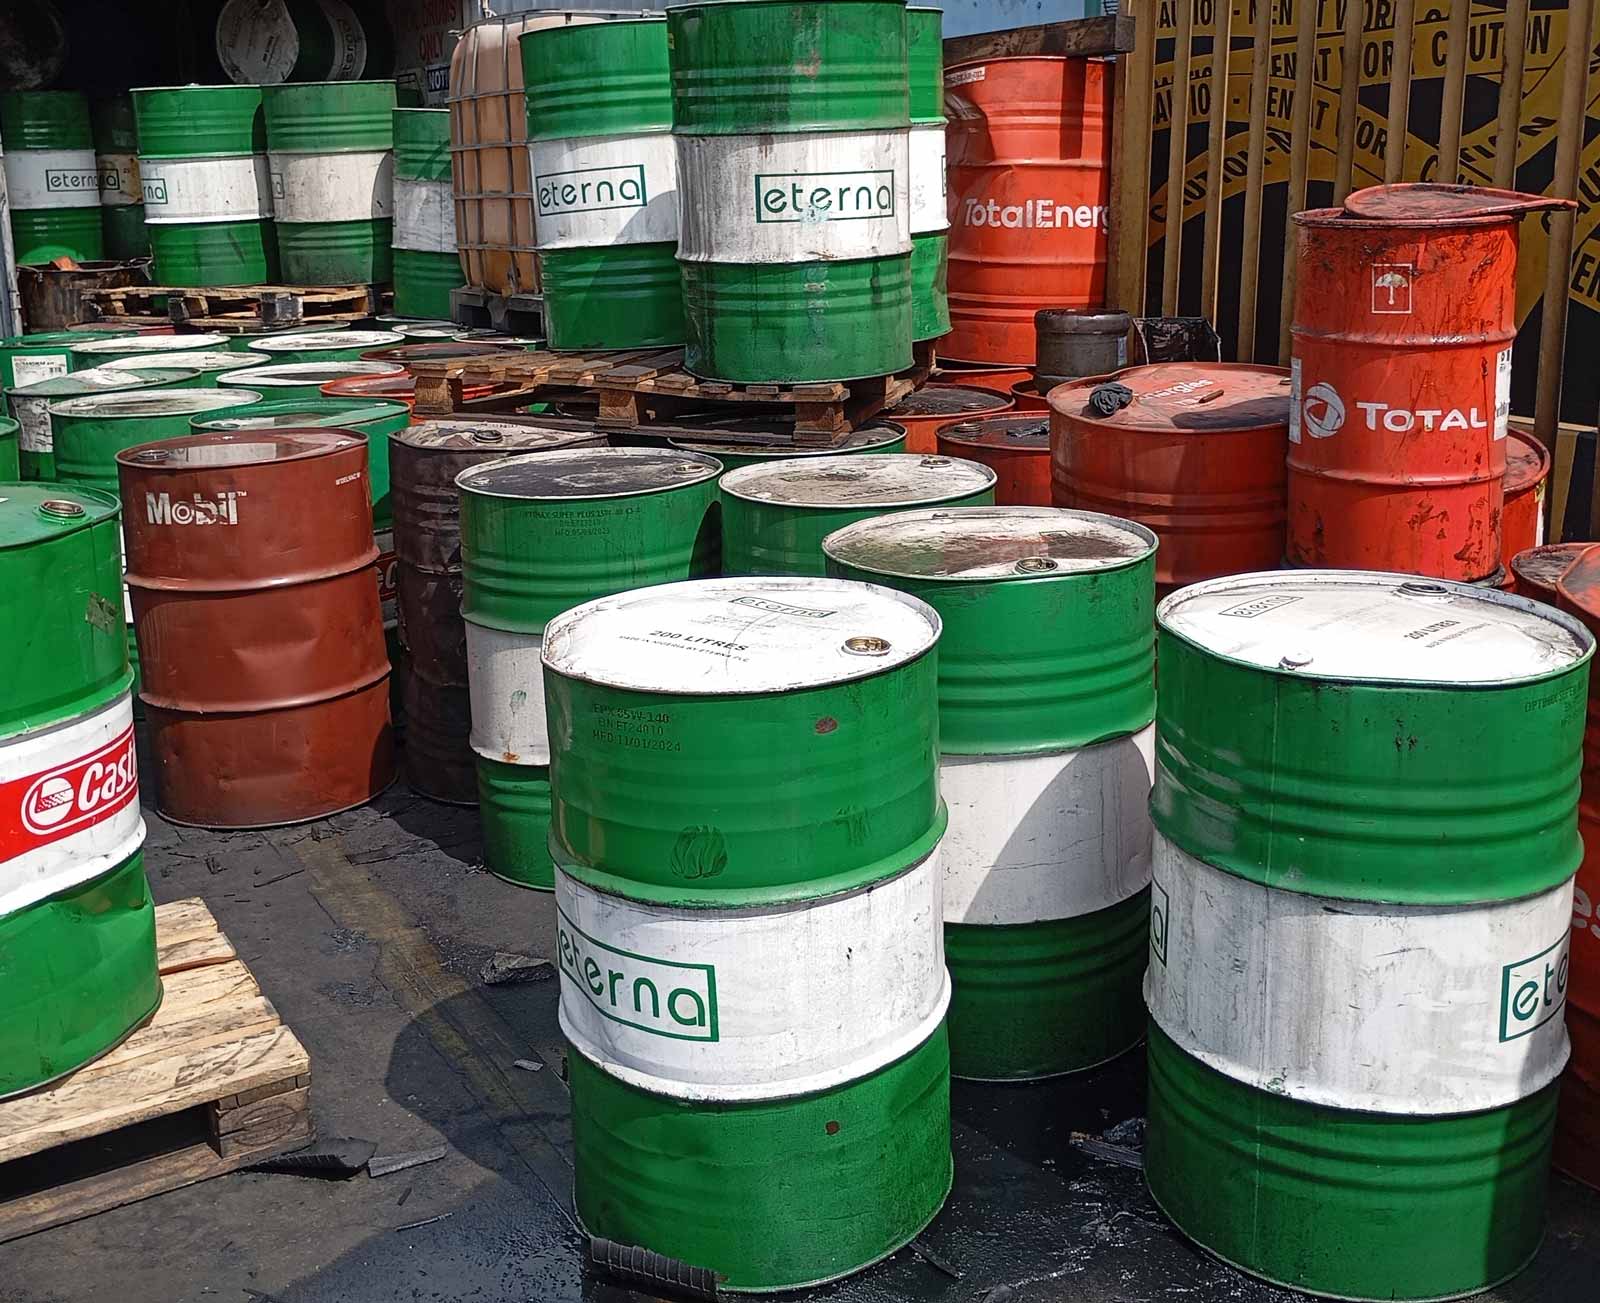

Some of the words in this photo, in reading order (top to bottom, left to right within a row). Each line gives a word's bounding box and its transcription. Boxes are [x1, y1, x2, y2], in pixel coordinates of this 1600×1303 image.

[1432, 15, 1551, 67] CUTN
[539, 178, 641, 208] eterna
[763, 182, 891, 213] eterna
[1356, 401, 1488, 433] TOTAL
[738, 597, 826, 618] eterna
[648, 630, 682, 640] 200
[683, 635, 750, 652] LITRES
[558, 927, 707, 1028] eterna
